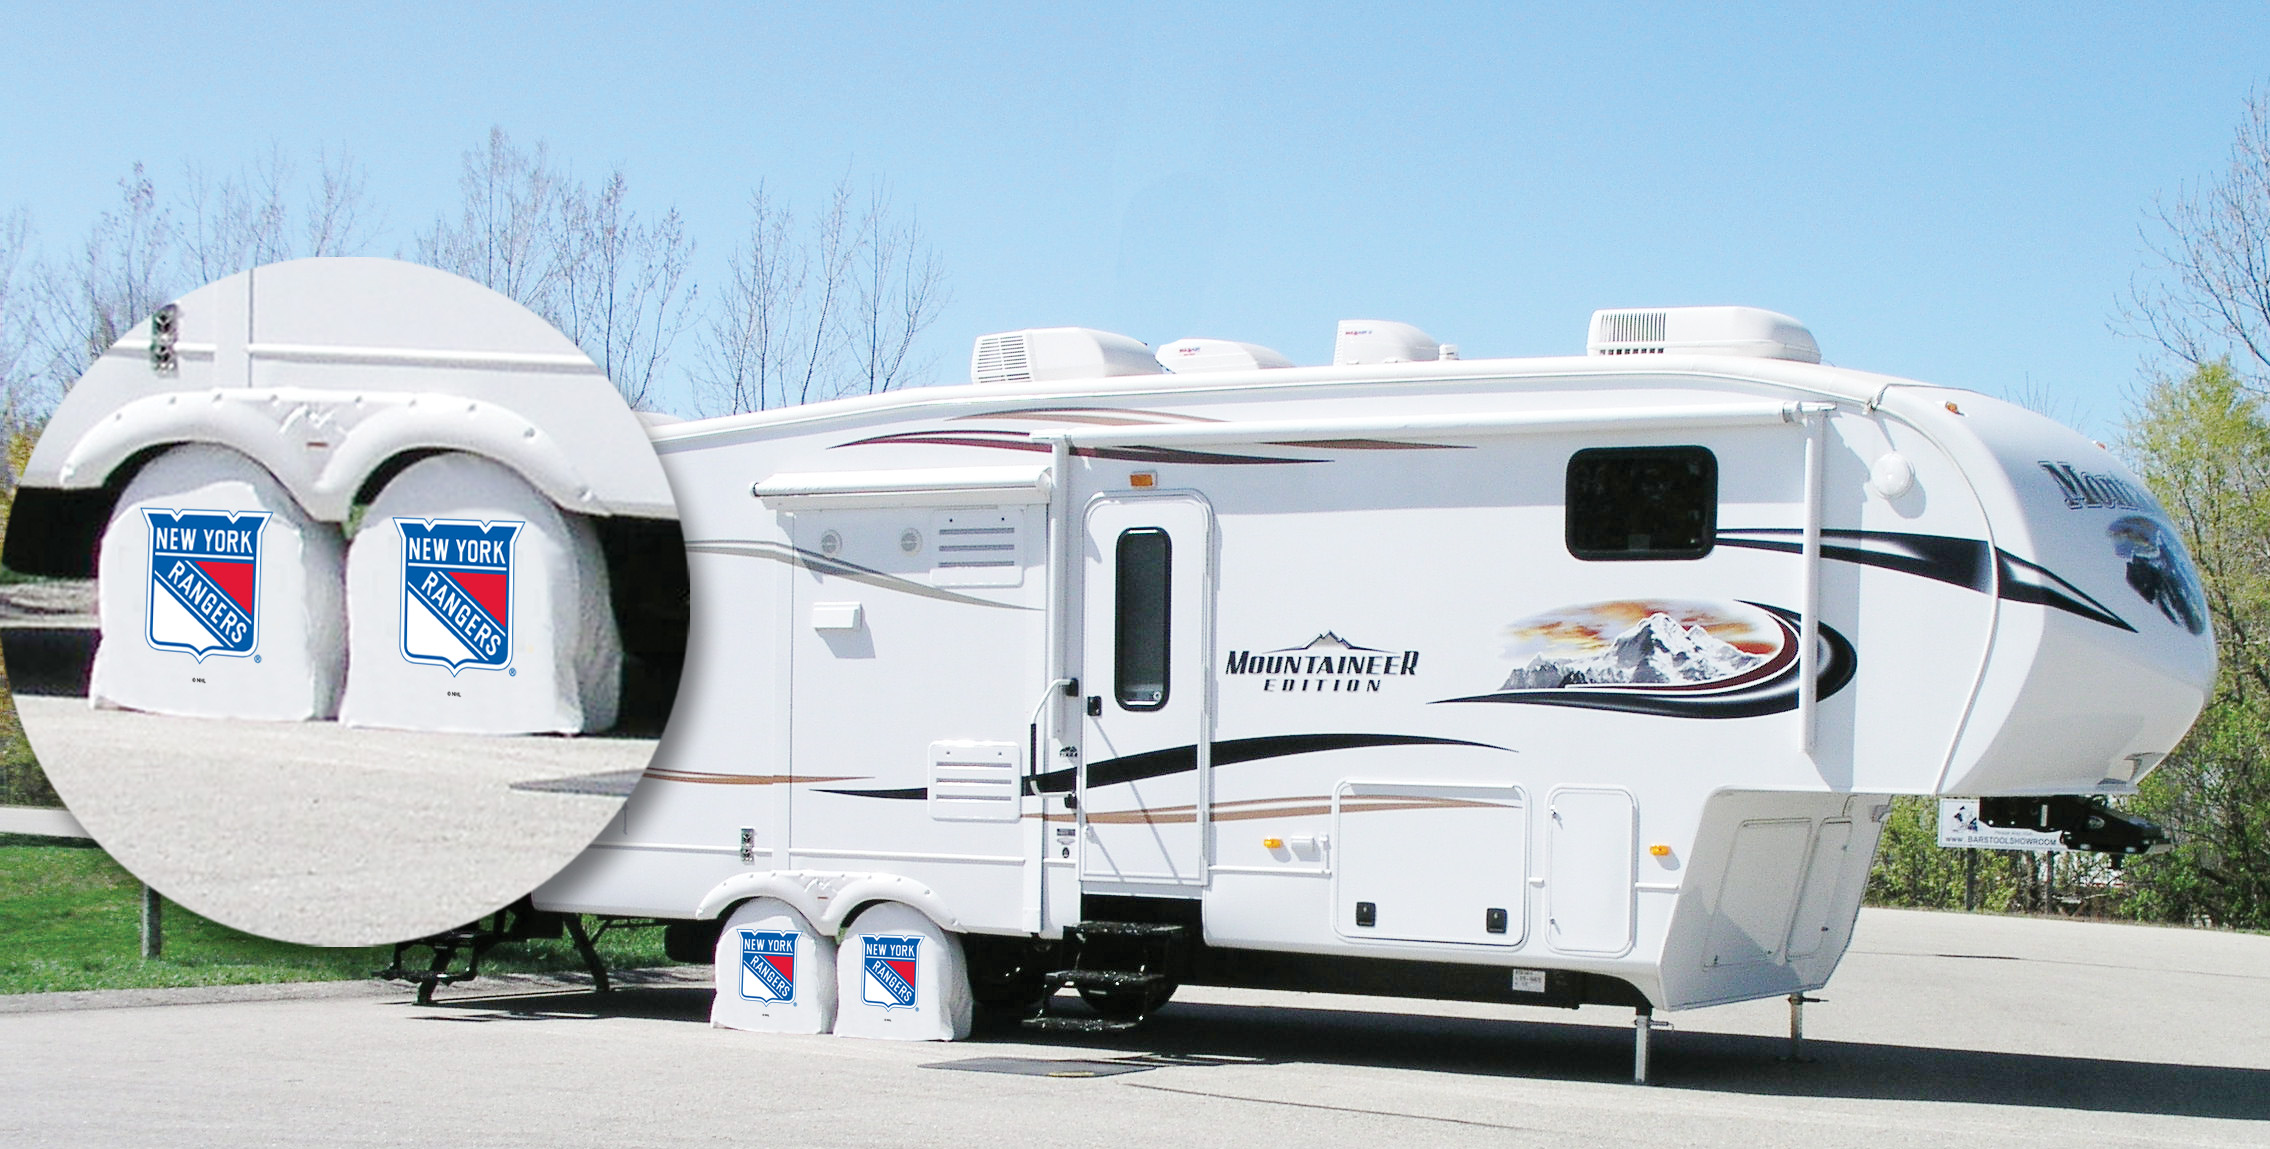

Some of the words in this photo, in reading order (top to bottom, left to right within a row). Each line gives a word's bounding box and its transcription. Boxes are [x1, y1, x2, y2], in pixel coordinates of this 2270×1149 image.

[156, 527, 197, 551] NEW
[203, 529, 253, 554] YORK
[408, 537, 449, 562] NEW
[456, 539, 506, 564] YORK
[167, 560, 247, 643] RANGERS
[421, 571, 501, 656] RANGERS
[1225, 650, 1419, 676] MOUNTAINEER
[1263, 678, 1381, 693] EDITION
[744, 938, 765, 951] NEW
[768, 939, 793, 953] YORK
[866, 943, 887, 956] NEW
[890, 944, 915, 957] YORK
[750, 955, 790, 997] RANGERS
[872, 960, 913, 1002] RANGERS
